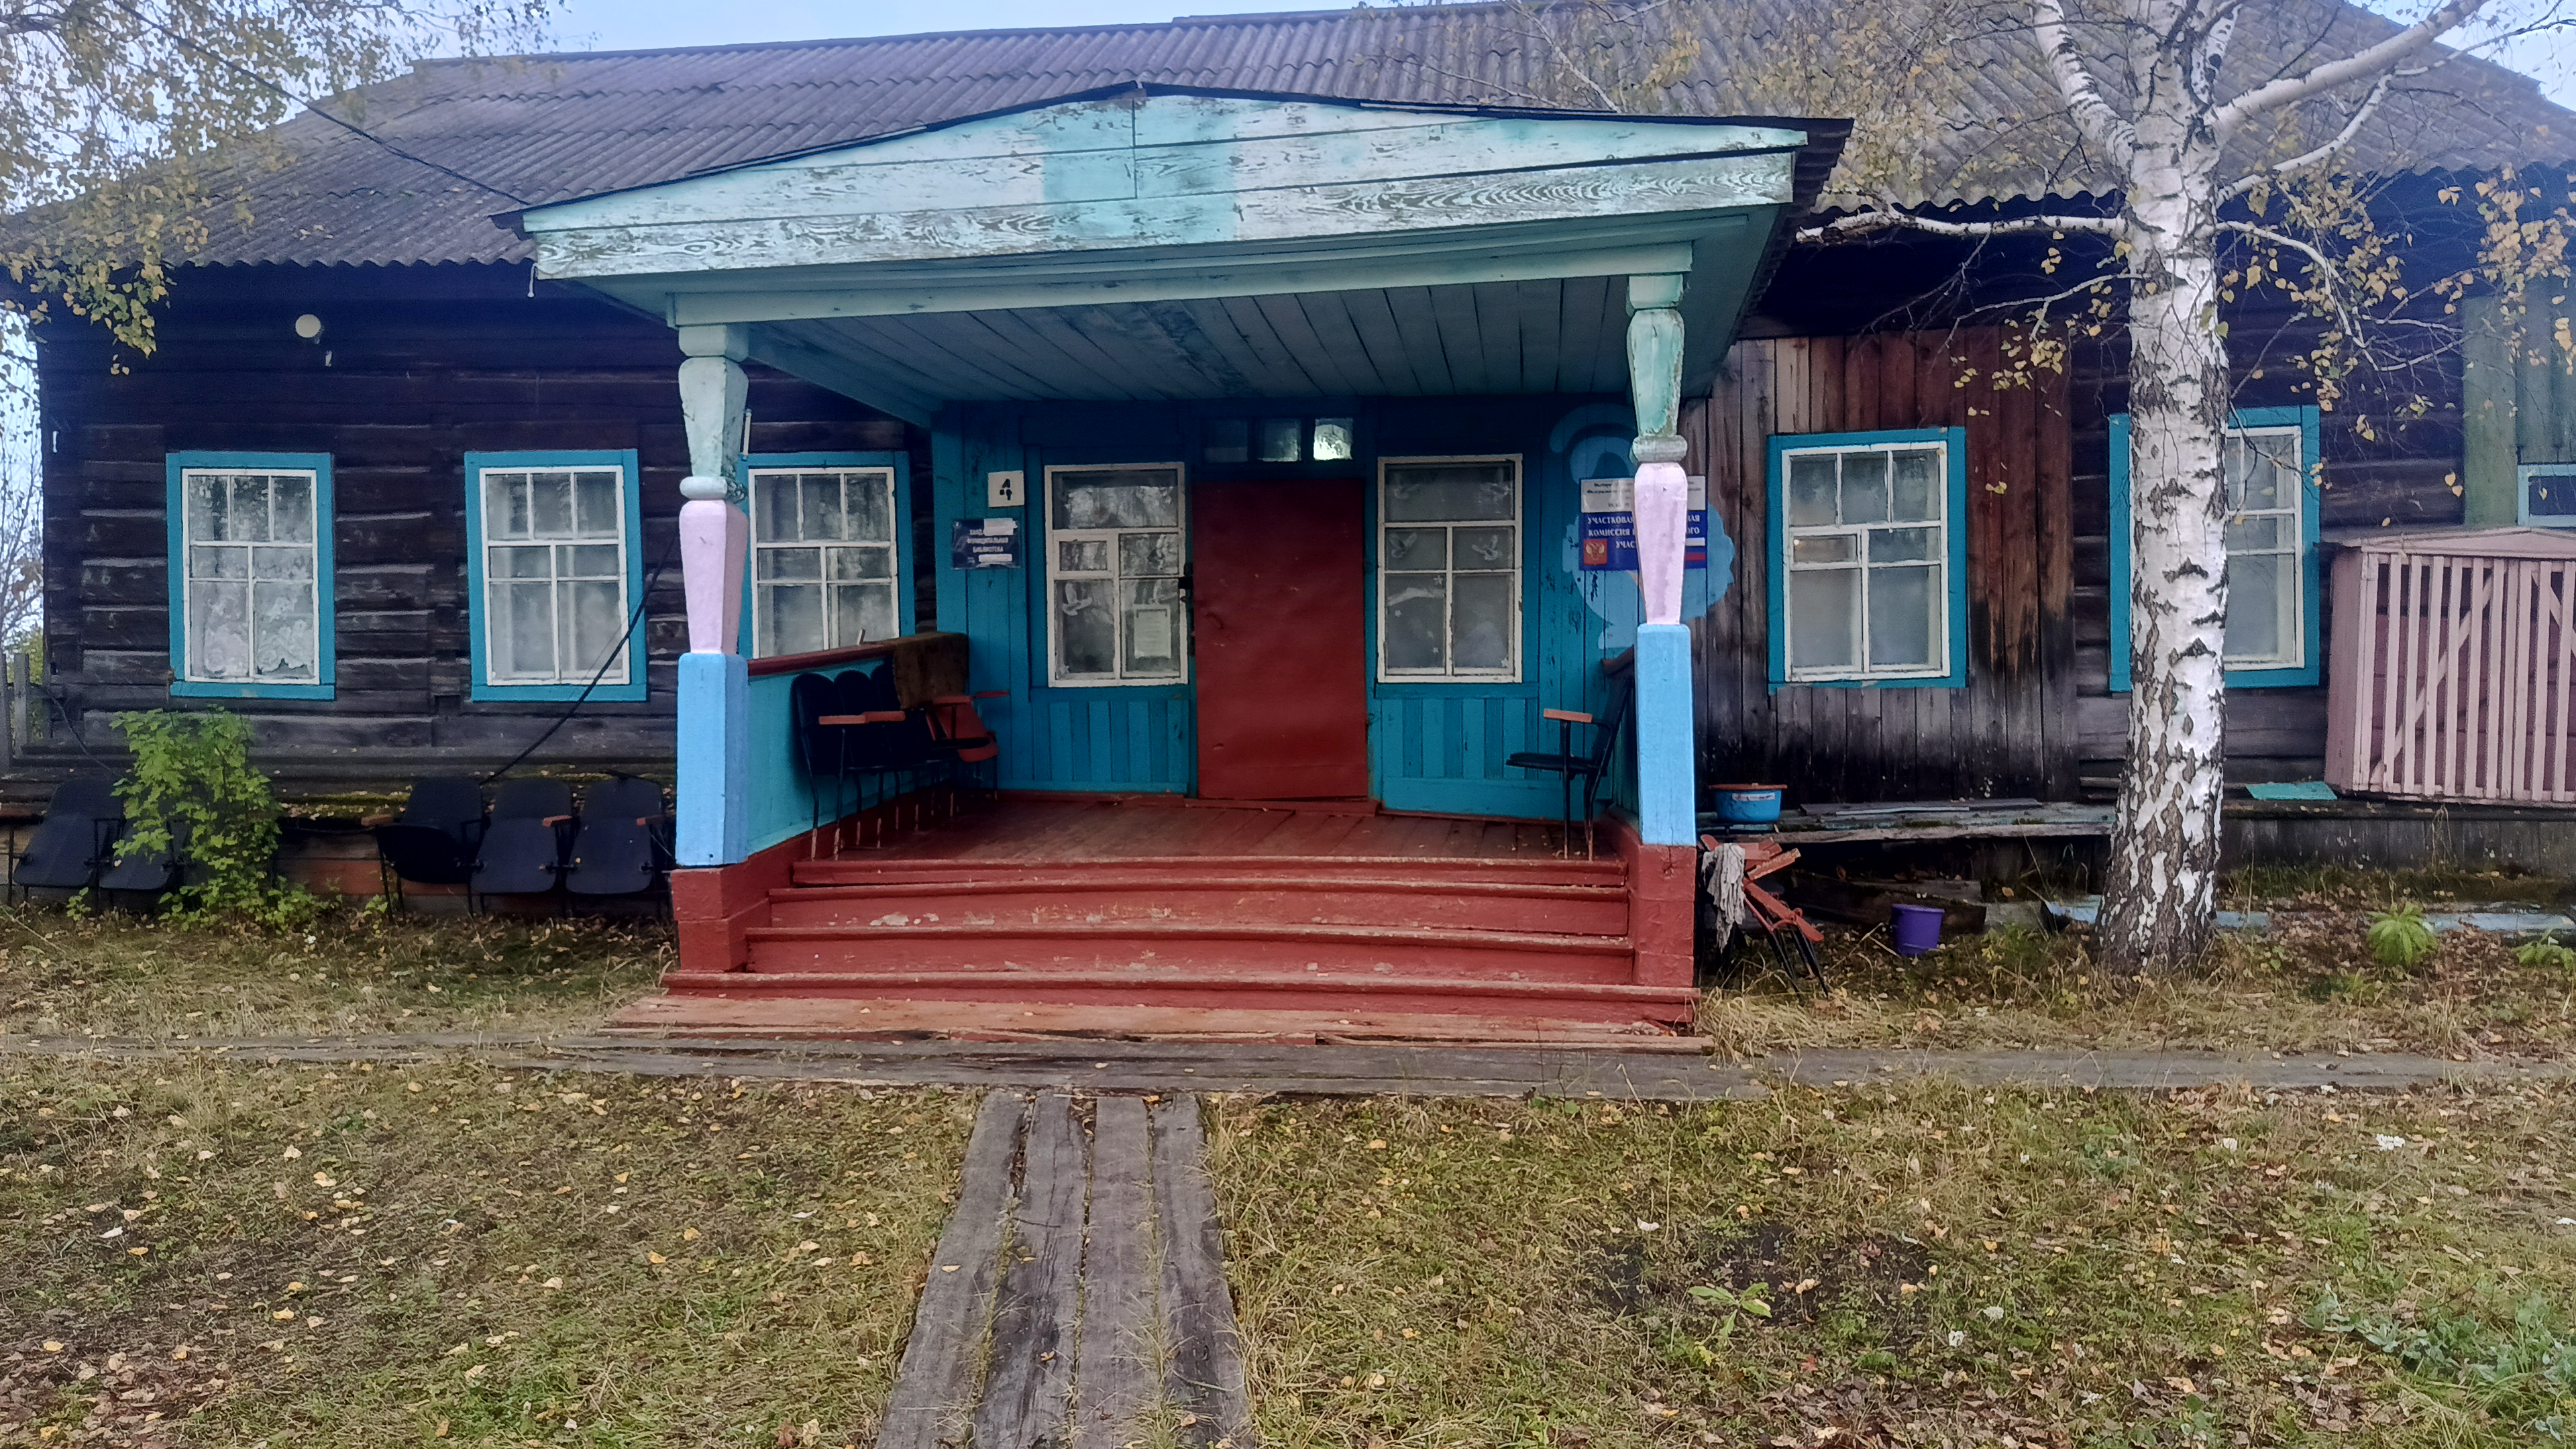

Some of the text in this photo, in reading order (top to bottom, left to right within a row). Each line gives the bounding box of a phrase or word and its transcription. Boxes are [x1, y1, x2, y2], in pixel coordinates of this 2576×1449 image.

[1000, 478, 1012, 500] 4
[1588, 528, 1630, 537] КОМИССИЯ
[1615, 540, 1637, 549] УЧАС
